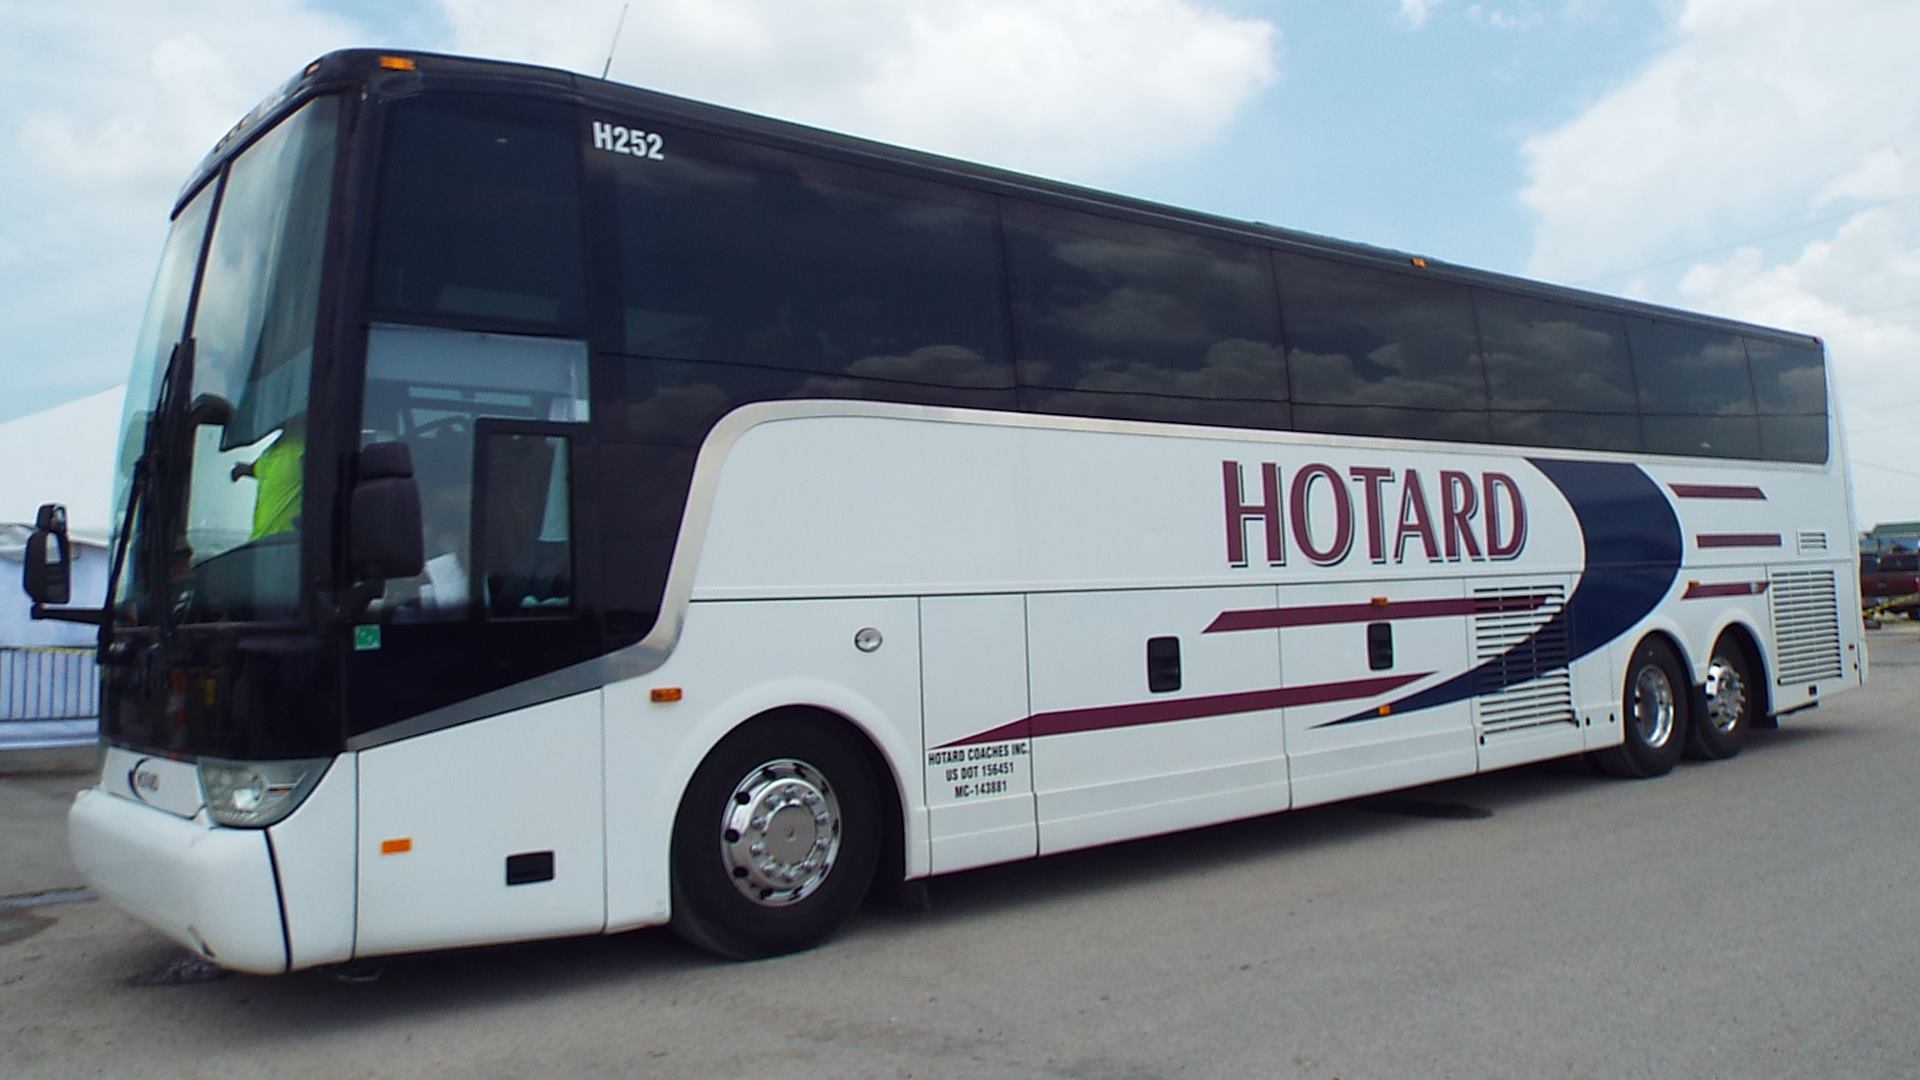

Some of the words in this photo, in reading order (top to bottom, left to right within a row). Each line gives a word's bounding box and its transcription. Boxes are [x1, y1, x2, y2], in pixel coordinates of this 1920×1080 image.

[592, 121, 665, 160] H252
[1222, 460, 1528, 568] HOTARD
[928, 749, 965, 765] HOTARD
[967, 745, 1009, 760] COACHES
[946, 768, 958, 781] US
[961, 765, 978, 780] DOT
[982, 762, 1014, 776] 156451
[955, 780, 1007, 798] MC-143881
